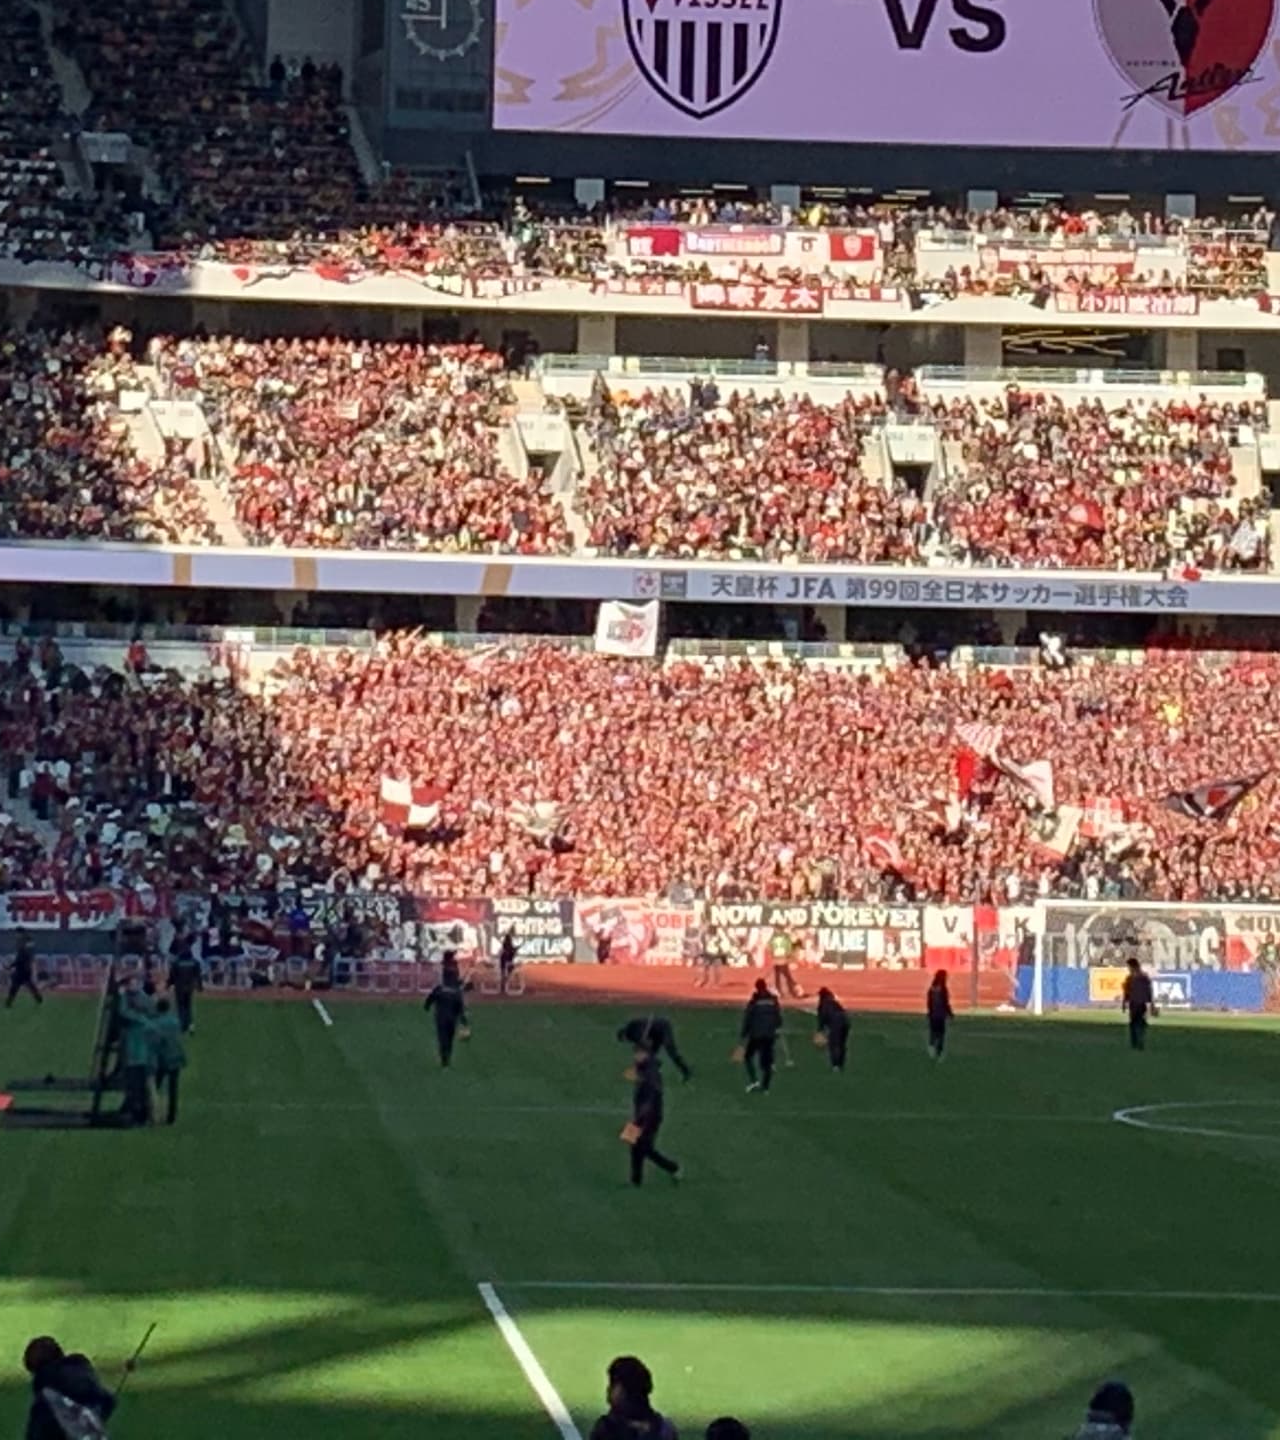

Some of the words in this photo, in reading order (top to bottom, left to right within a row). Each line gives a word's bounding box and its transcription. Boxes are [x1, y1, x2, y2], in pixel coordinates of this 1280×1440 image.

[711, 573, 778, 599] 天皇杯
[786, 577, 836, 600] JFA
[711, 906, 763, 926] NOW
[769, 908, 807, 926] AND
[810, 902, 920, 927] FOREVER
